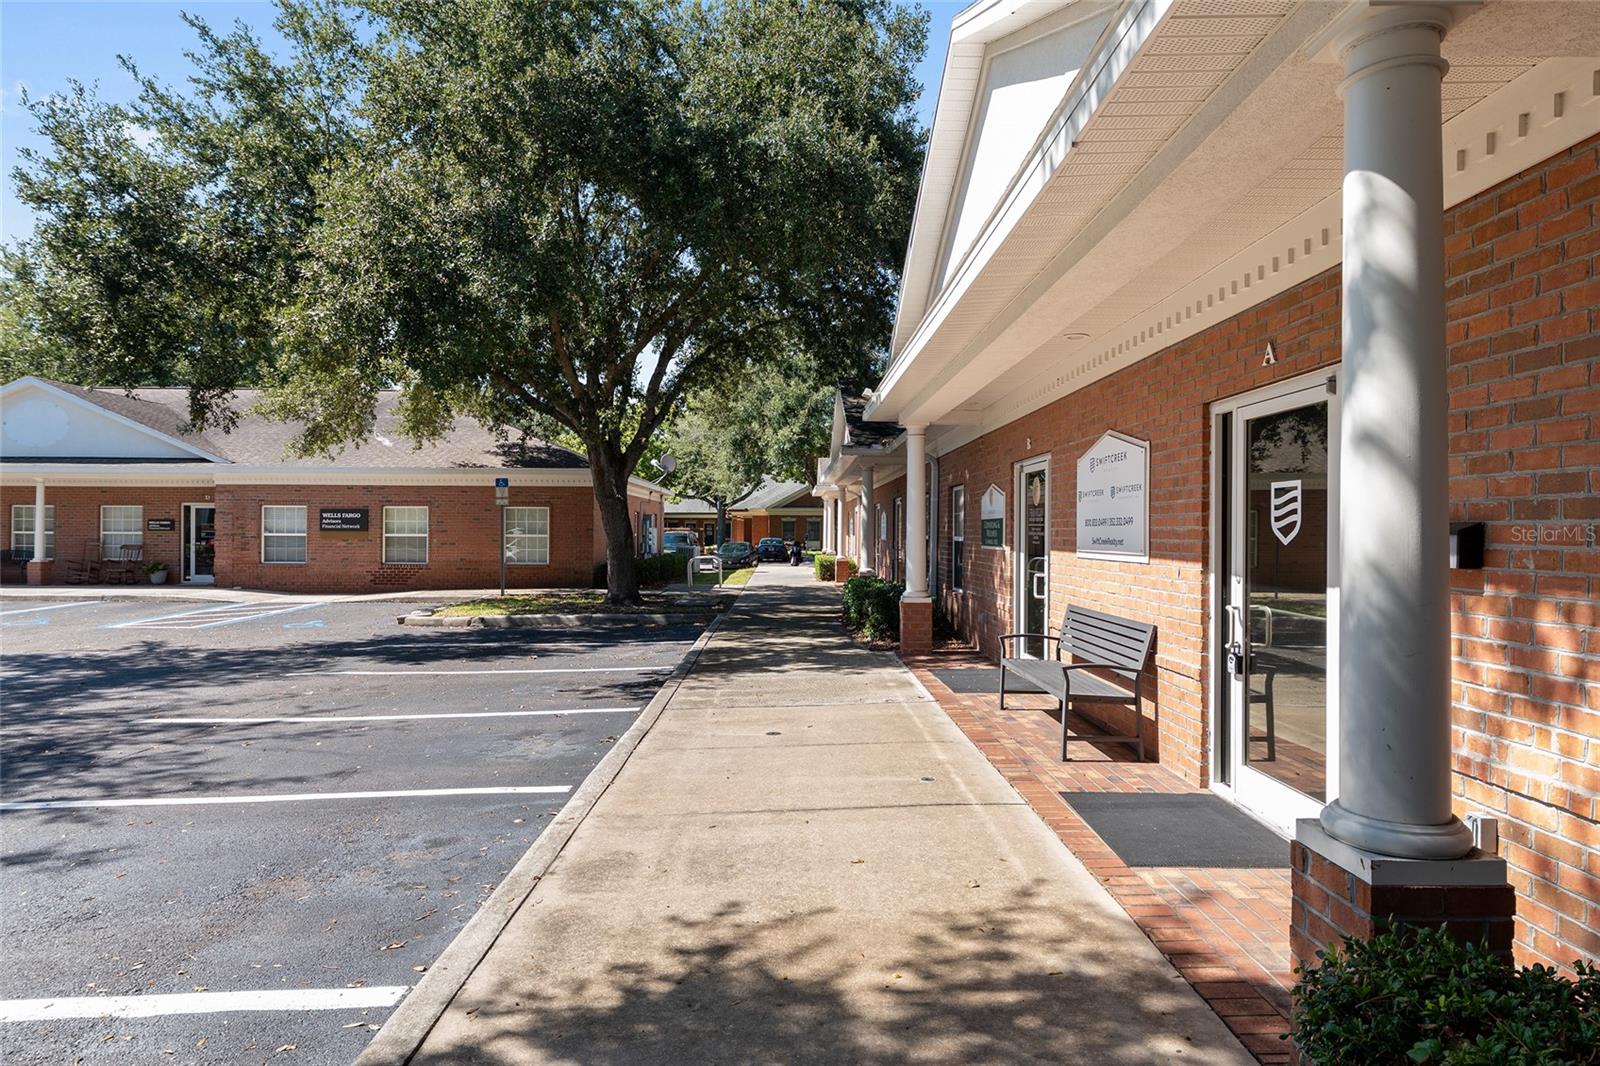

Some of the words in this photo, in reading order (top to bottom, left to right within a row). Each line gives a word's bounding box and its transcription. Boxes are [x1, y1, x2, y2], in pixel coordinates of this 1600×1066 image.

[1262, 342, 1276, 366] A
[1096, 451, 1127, 466] SWIFTCREEK
[1116, 484, 1142, 494] SWIFTCREEK
